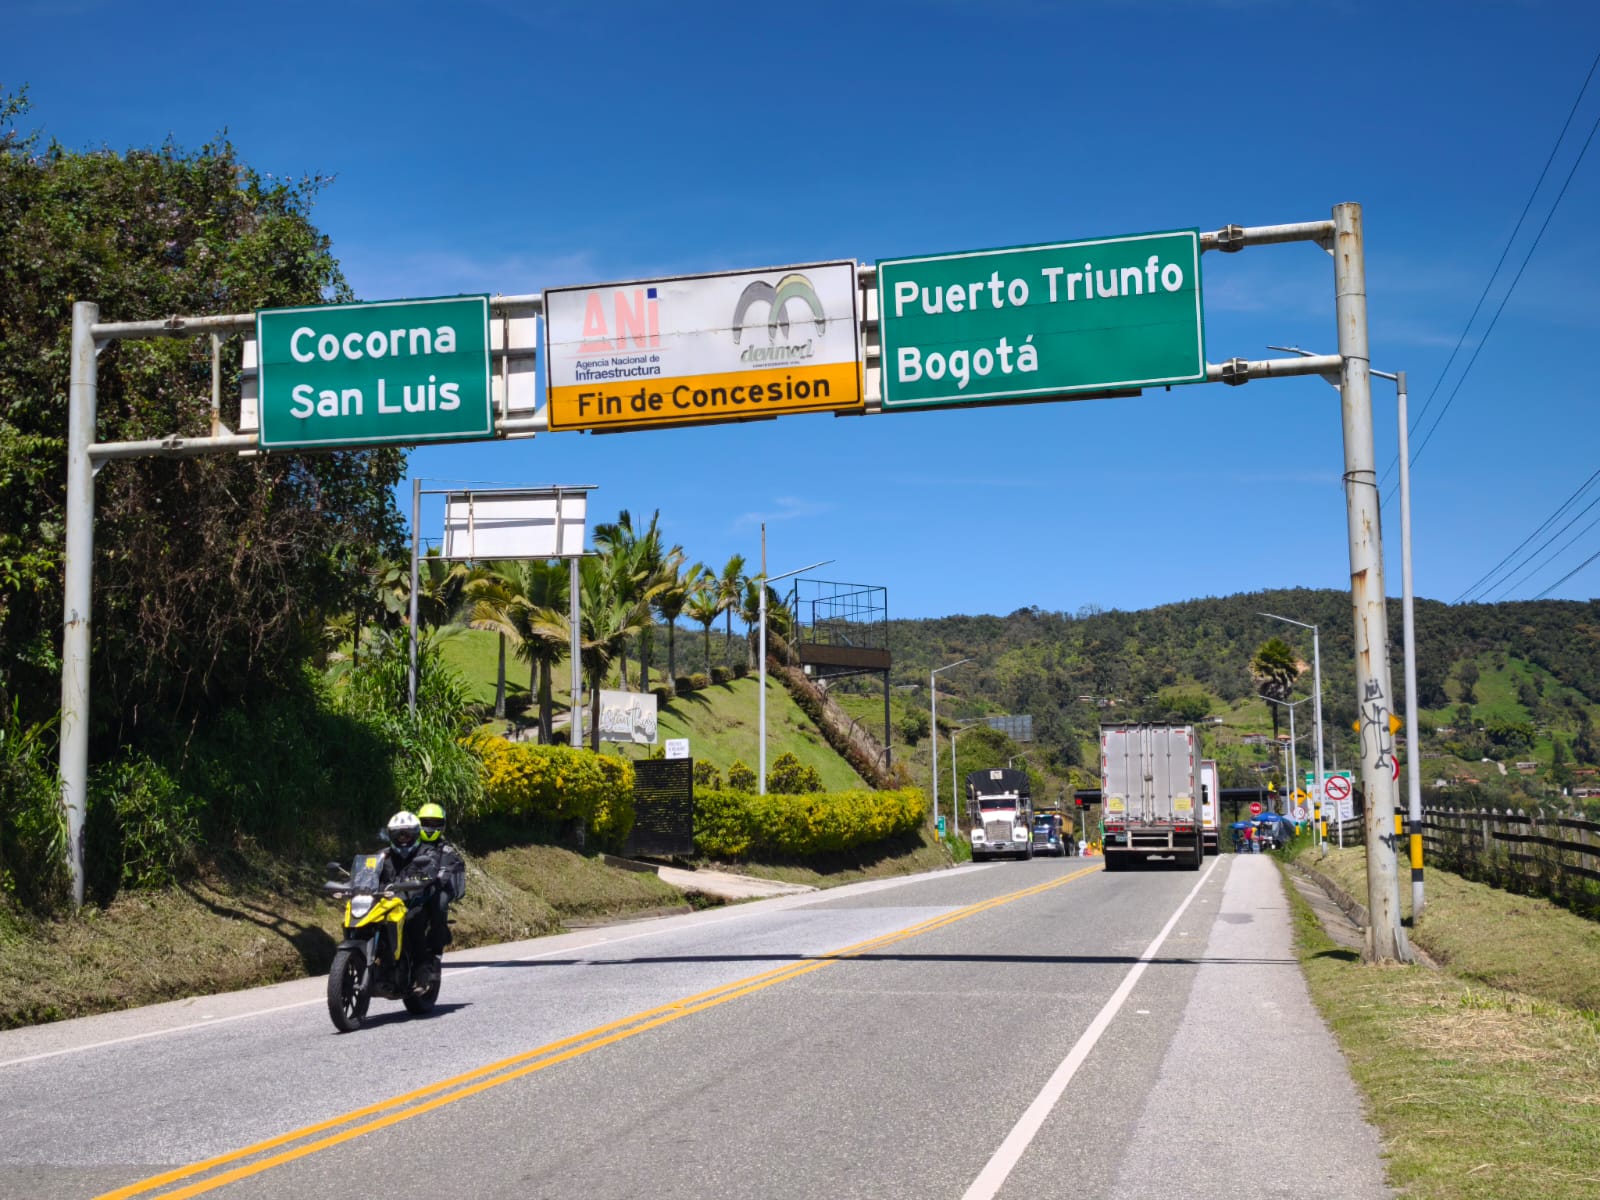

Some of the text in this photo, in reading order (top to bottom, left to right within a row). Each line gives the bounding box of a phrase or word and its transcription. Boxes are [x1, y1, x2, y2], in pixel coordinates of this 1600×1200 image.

[895, 255, 1184, 317] Puerto Triunfo
[290, 326, 457, 363] Cocorna
[576, 354, 660, 370] Agencia Nacional de
[897, 334, 1039, 390] Bogotá
[575, 366, 661, 381] Infraestructura
[290, 375, 461, 419] San Luis
[578, 375, 831, 417] Fin de Concesion
